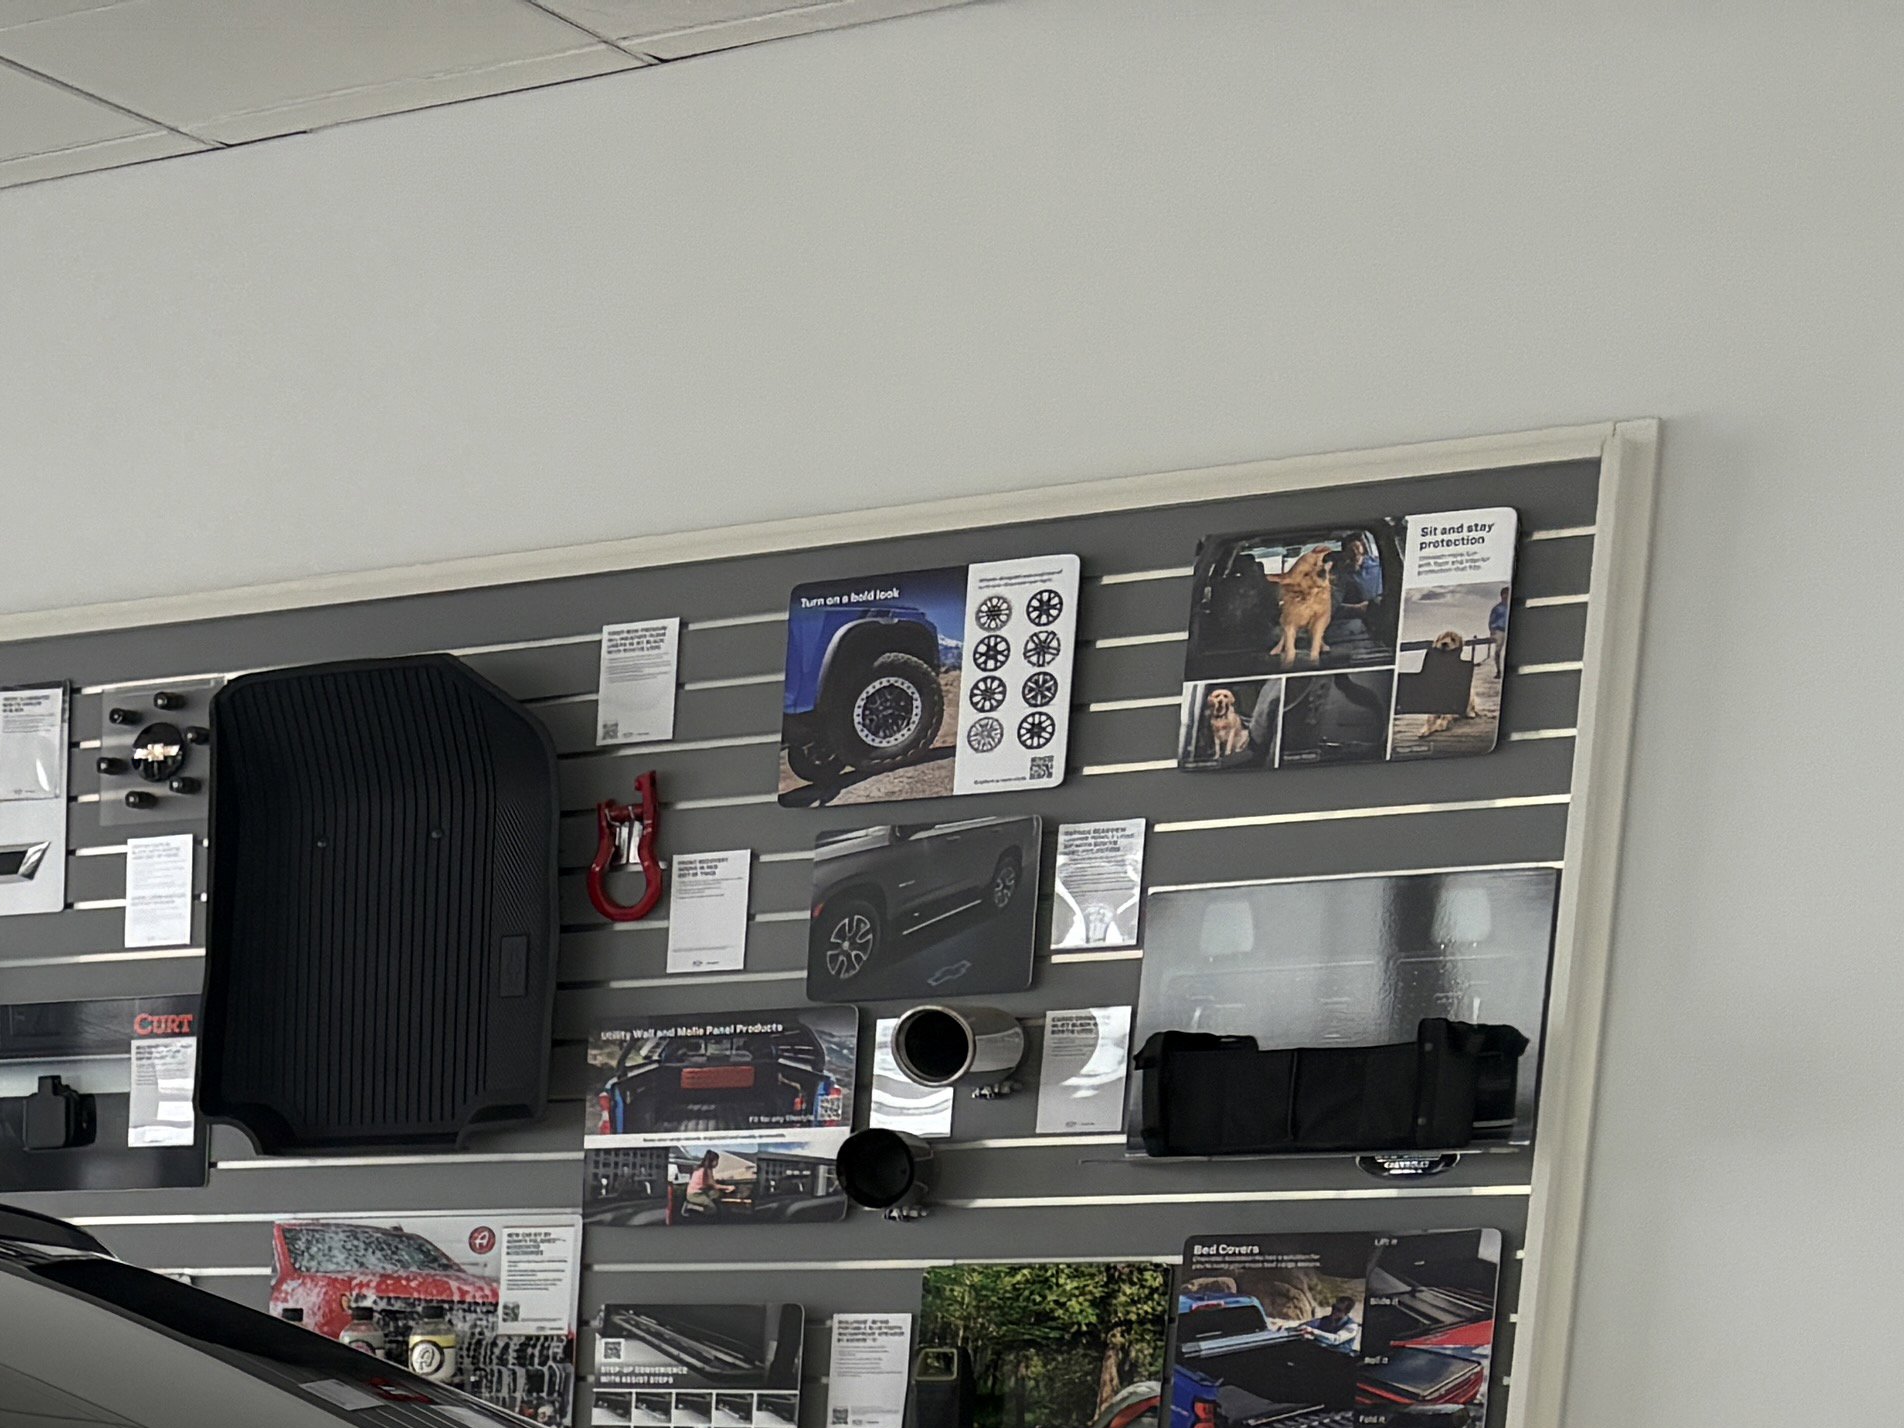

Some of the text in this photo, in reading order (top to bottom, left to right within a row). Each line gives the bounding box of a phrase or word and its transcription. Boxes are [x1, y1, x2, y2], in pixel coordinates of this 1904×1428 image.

[1420, 522, 1495, 538] Sit and stay
[1419, 535, 1485, 551] protection
[800, 588, 900, 609] Turn on a bold look
[134, 1013, 195, 1035] CURT
[600, 1029, 631, 1042] Utility
[632, 1027, 655, 1039] Wall
[656, 1027, 675, 1038] and
[706, 1024, 734, 1035] Panel
[736, 1022, 784, 1034] Products
[1193, 1244, 1259, 1255] Bed Covers
